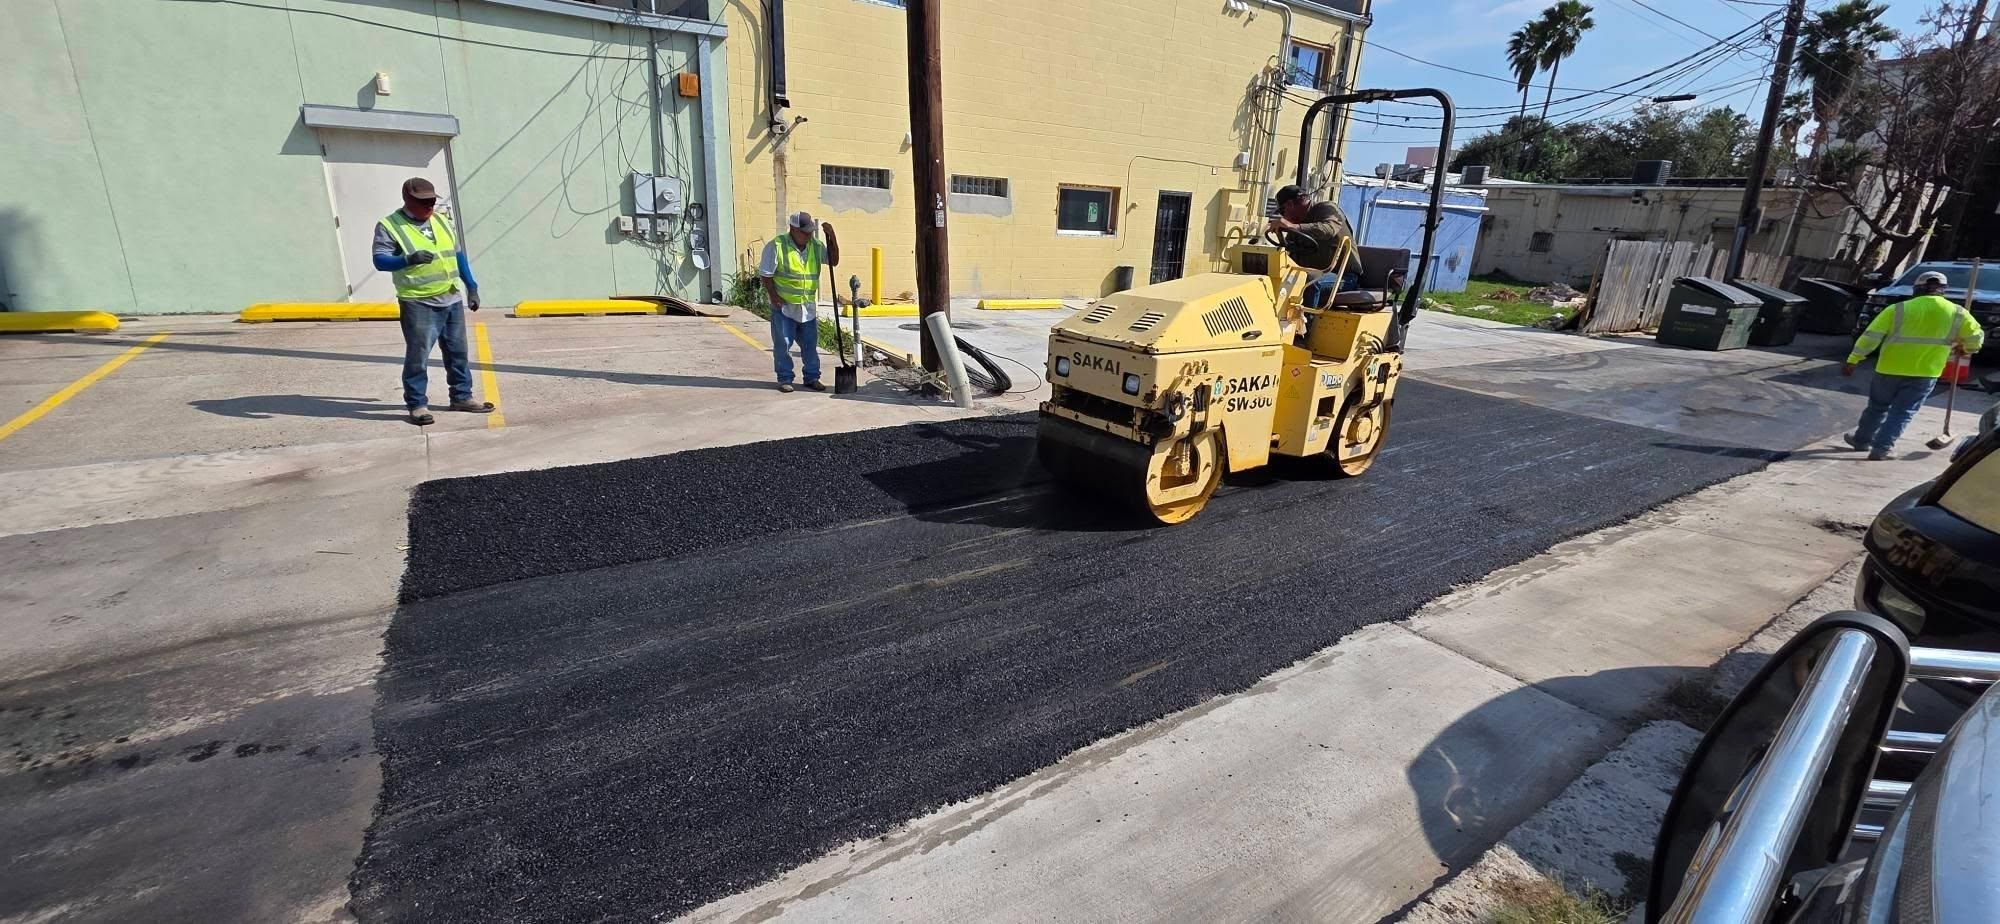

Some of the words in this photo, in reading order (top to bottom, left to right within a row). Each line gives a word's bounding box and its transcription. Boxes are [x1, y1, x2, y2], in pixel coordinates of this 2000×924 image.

[1073, 351, 1121, 376] SAKAI
[1229, 374, 1279, 395] SAKAI
[1227, 396, 1273, 413] SW300
